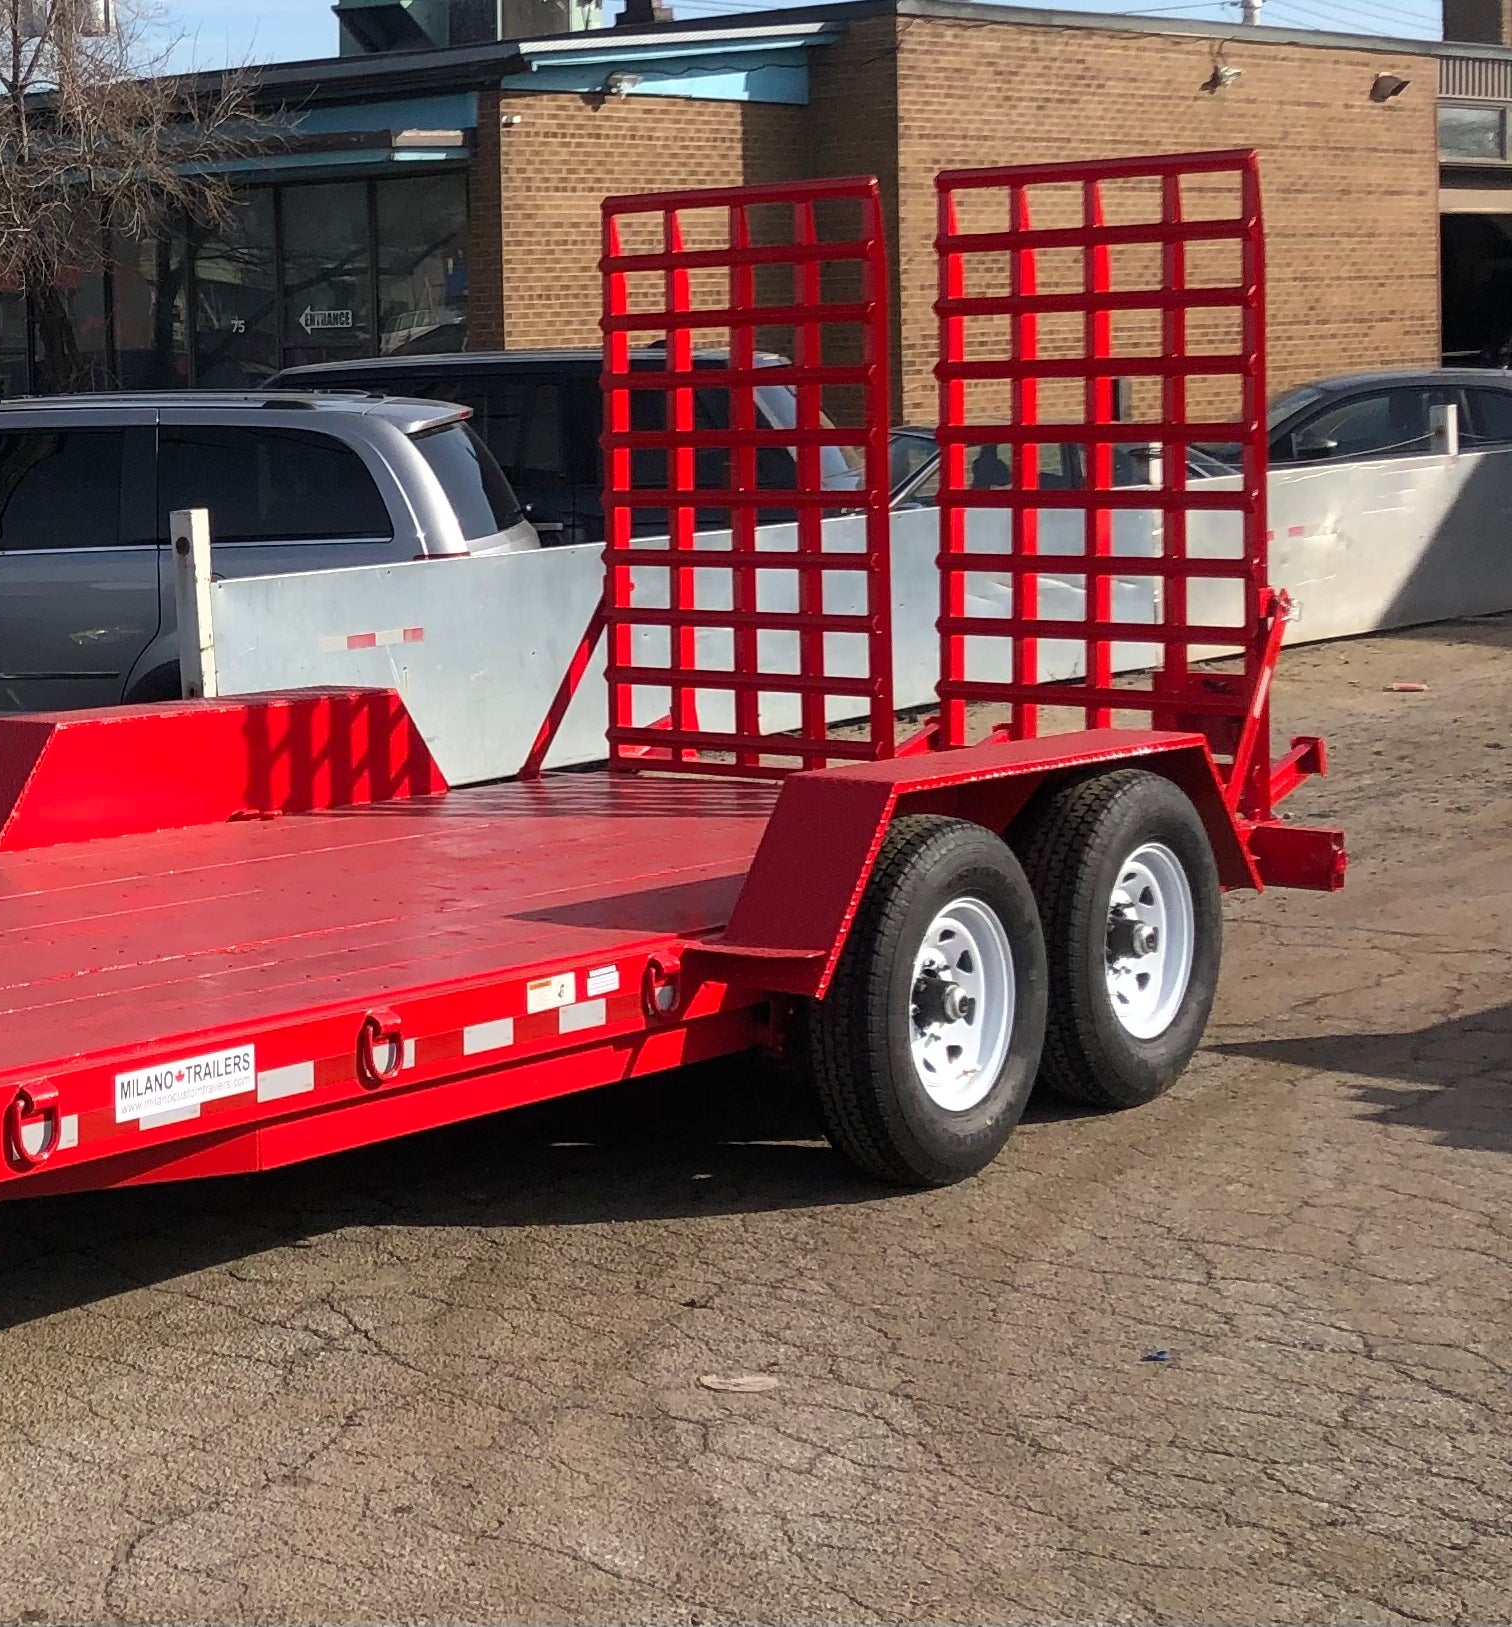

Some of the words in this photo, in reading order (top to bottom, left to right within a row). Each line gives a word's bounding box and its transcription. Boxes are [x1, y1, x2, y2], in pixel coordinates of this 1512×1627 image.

[230, 319, 245, 333] 75
[305, 311, 350, 327] ENTRANCE
[121, 1070, 174, 1100] MILANO
[185, 1053, 250, 1084] TRAILERS
[121, 1076, 250, 1114] www.milanocustomtrailers.com
